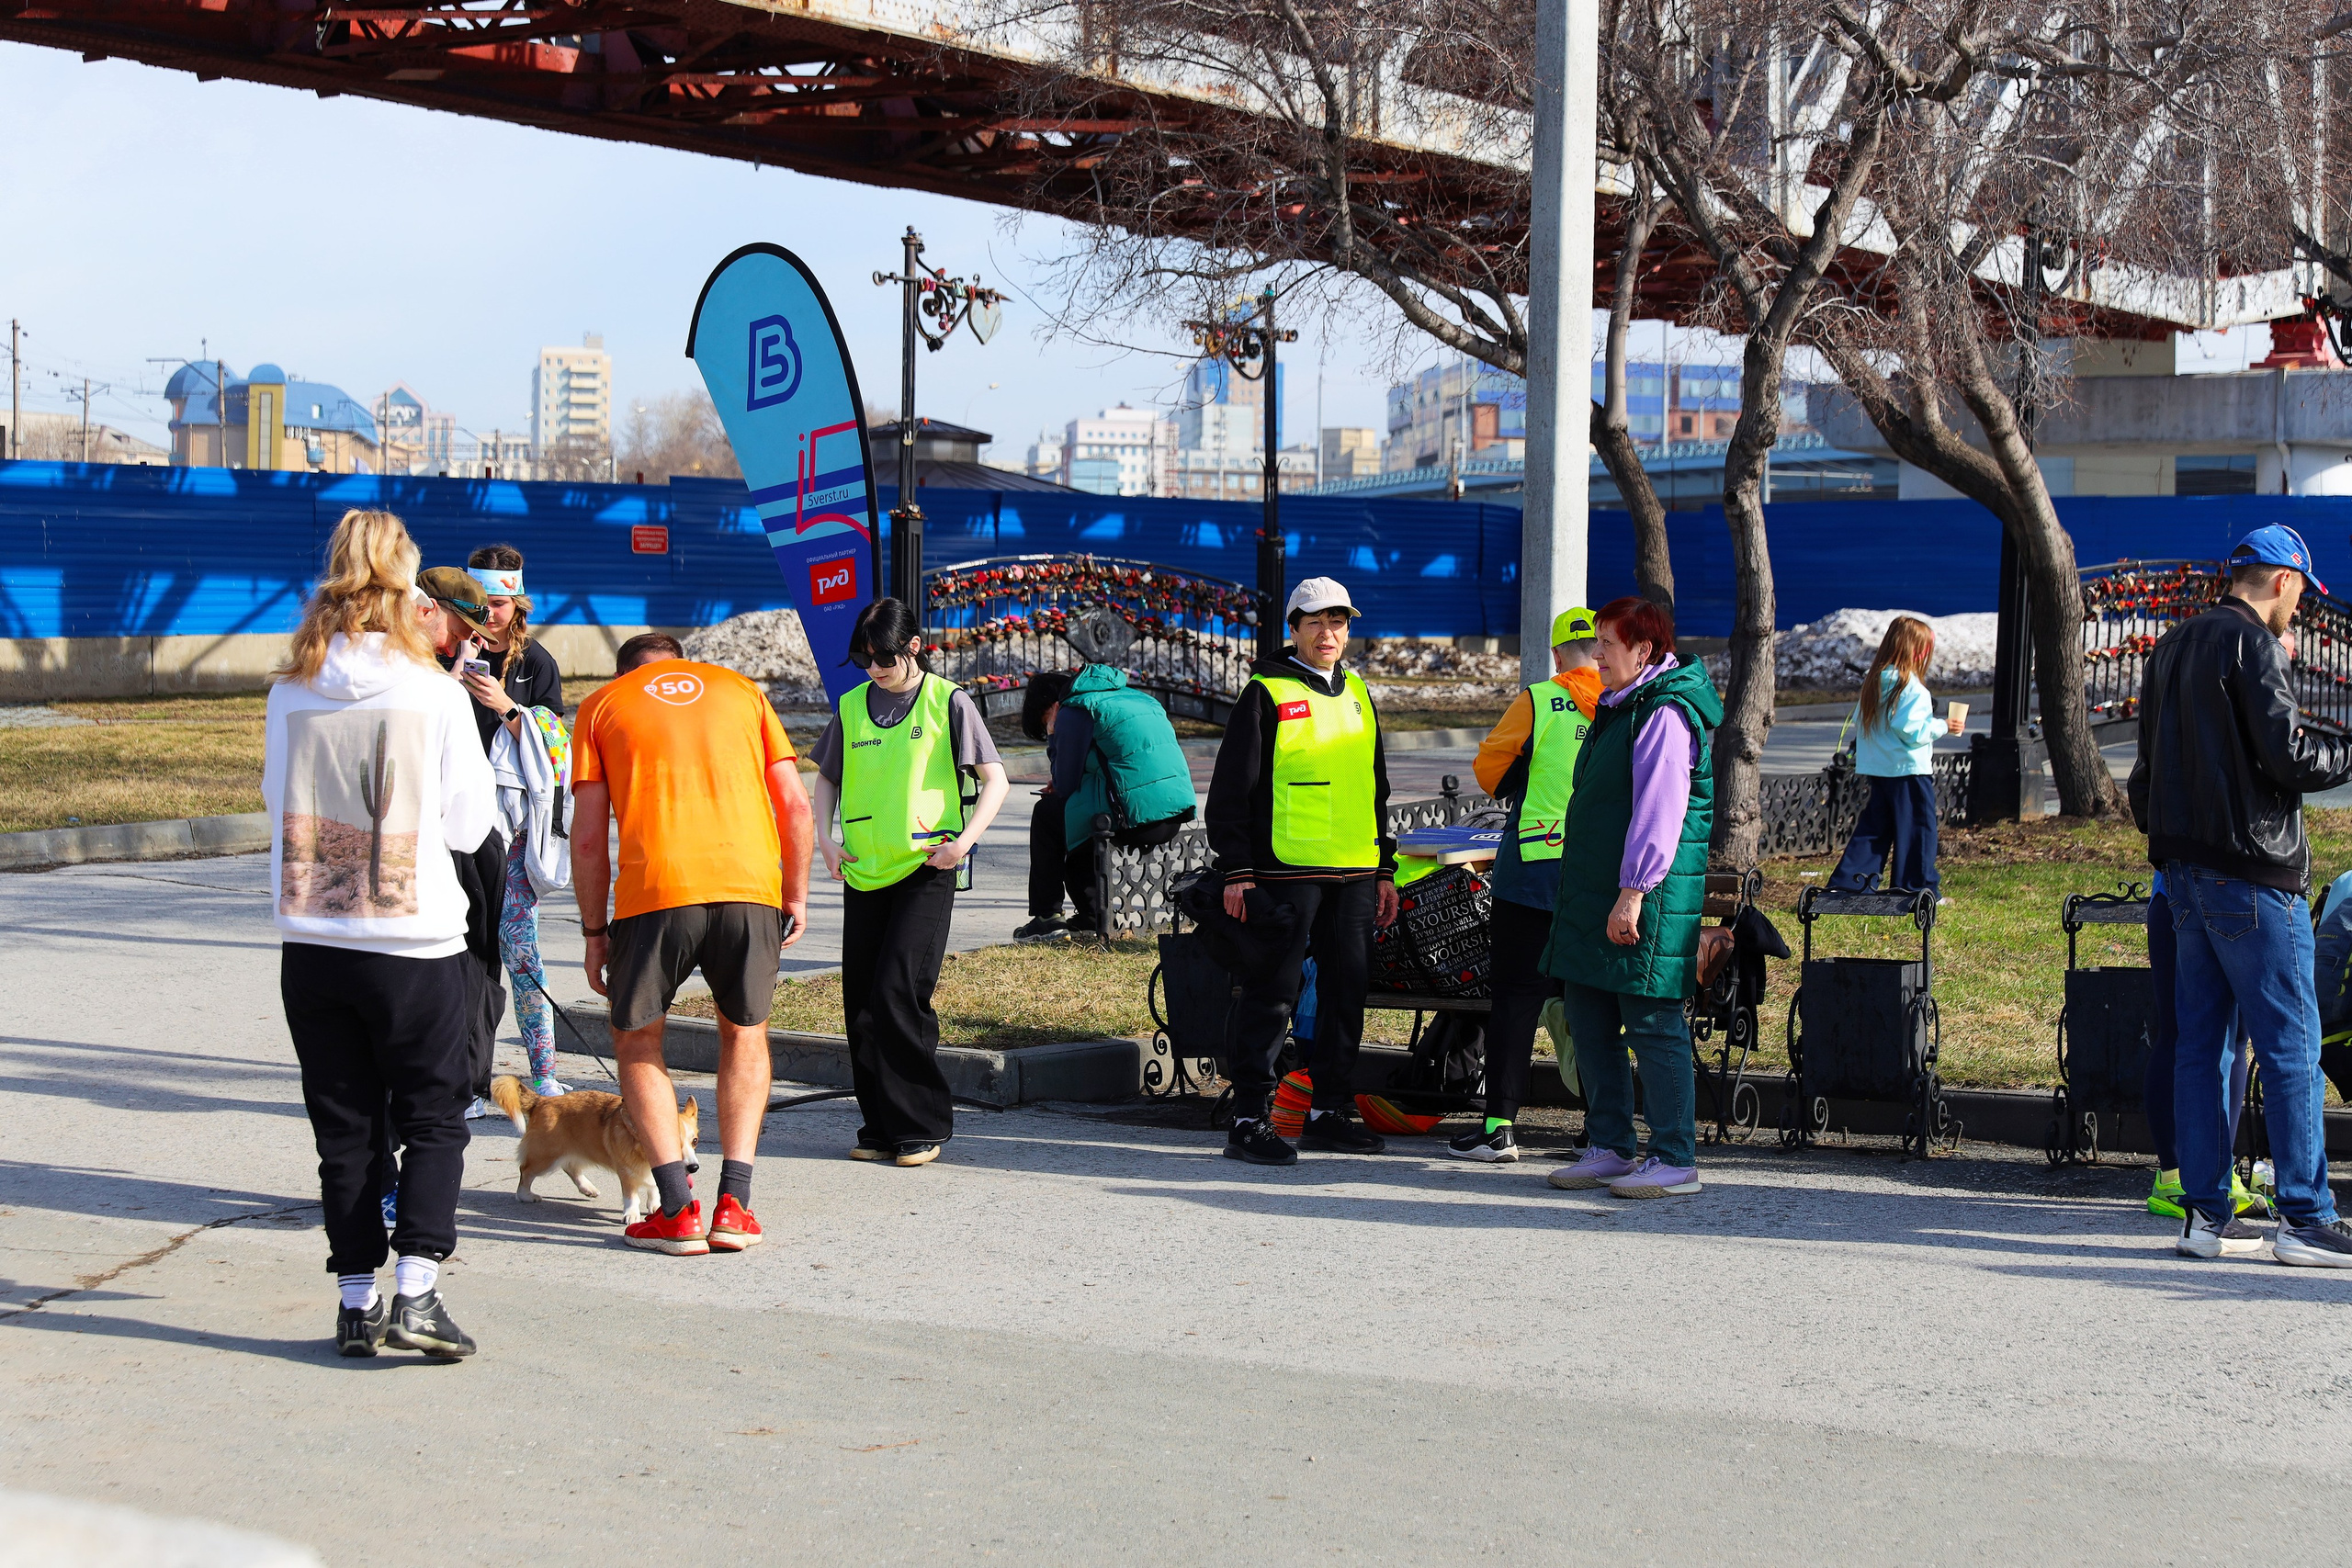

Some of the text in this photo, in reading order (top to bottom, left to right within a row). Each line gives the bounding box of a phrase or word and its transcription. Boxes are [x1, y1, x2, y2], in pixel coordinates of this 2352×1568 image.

[808, 488, 849, 507] 5verst.ru
[806, 548, 857, 564] ОФИЦИАЛЬНЫЙ ПАРТНЕР
[662, 680, 695, 695] 50
[851, 738, 882, 749] Волонтёр
